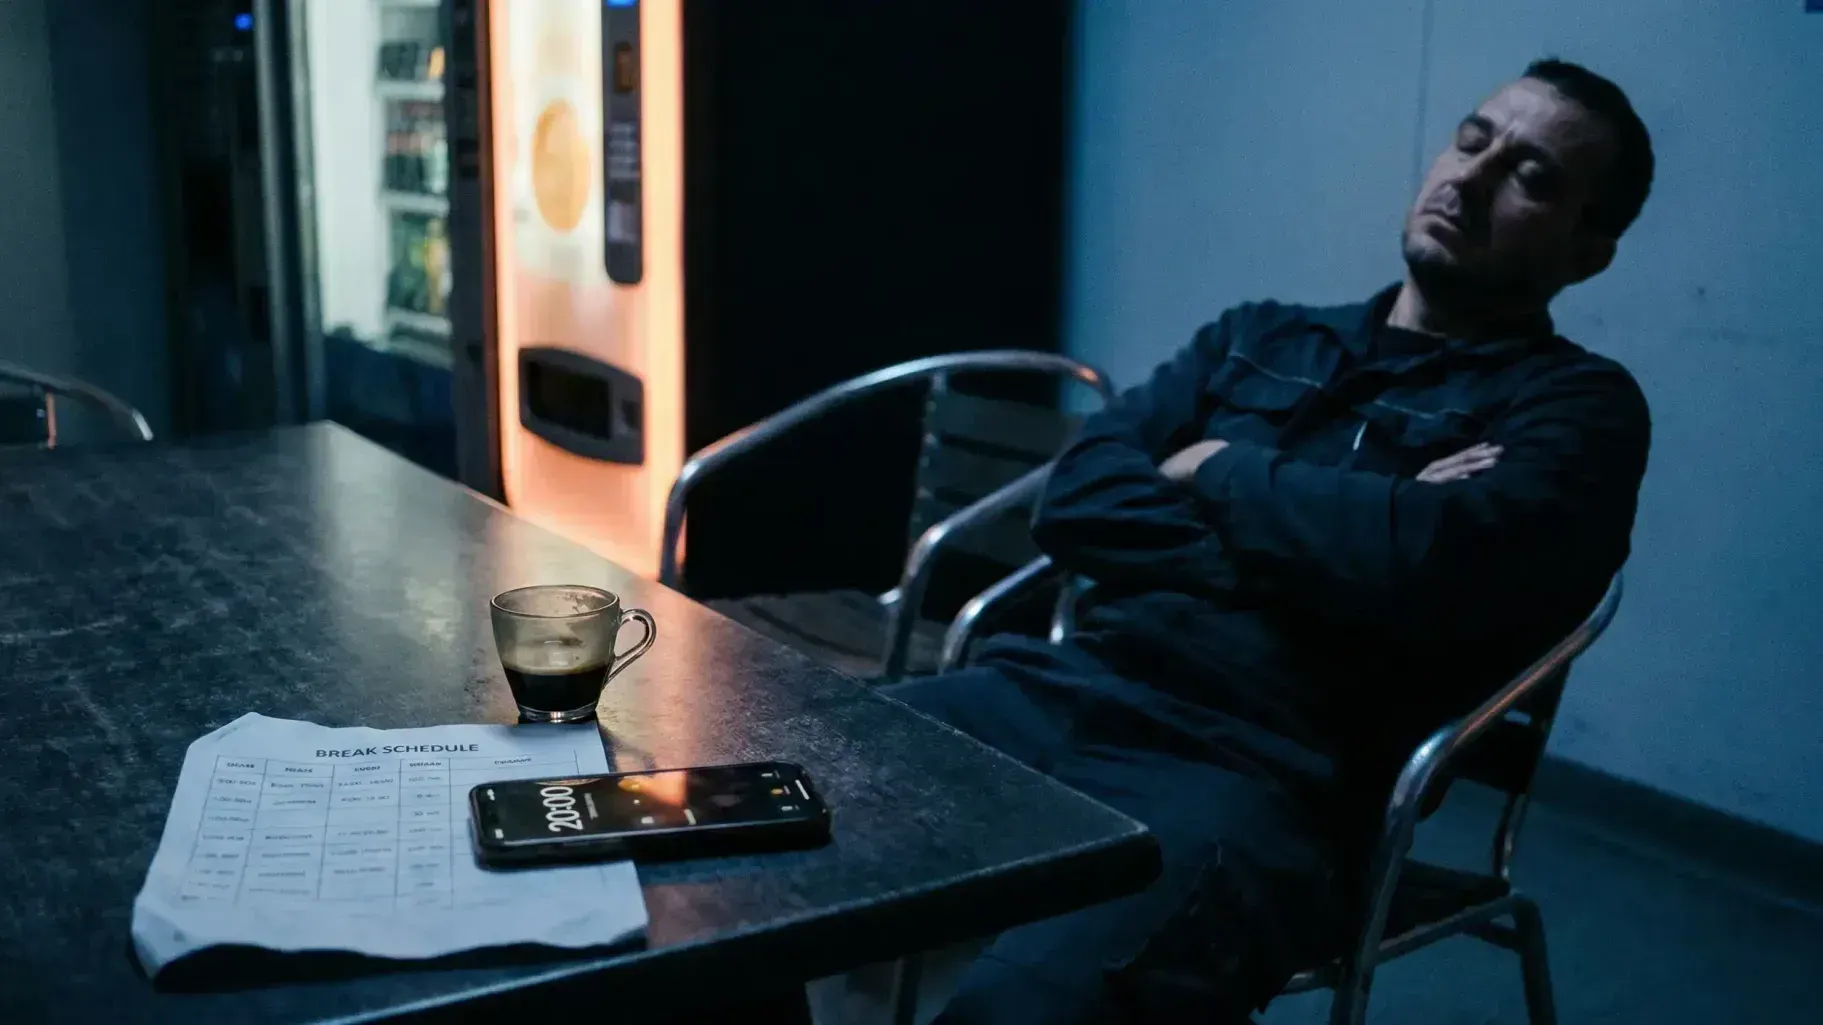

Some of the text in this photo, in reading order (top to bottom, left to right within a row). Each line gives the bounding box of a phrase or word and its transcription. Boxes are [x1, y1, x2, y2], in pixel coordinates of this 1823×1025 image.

[315, 744, 479, 758] BREAK SCHEDULE
[540, 786, 584, 832] 20:00
